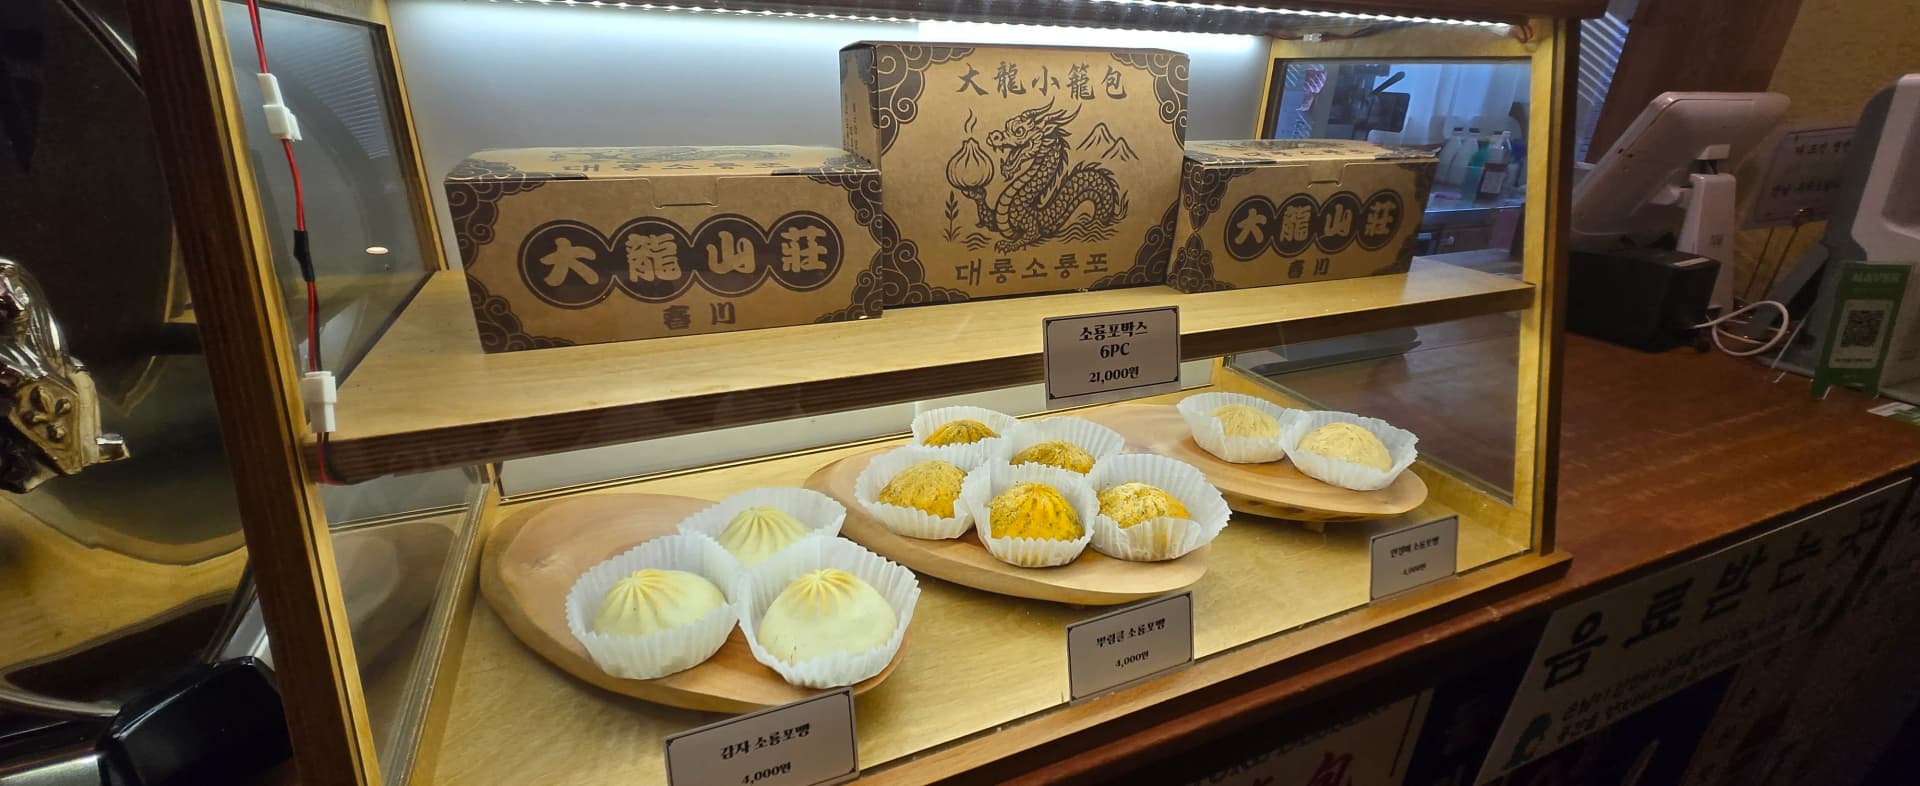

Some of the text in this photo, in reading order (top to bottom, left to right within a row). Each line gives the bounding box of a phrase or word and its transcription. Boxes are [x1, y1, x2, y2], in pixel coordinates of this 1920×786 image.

[956, 61, 1127, 100] 大龍小籠包
[1234, 196, 1397, 244] 大龍山莊
[539, 225, 829, 287] 大龍山莊
[955, 252, 1109, 286] 대룡소룡포
[1079, 321, 1149, 341] 소룡포박스
[1100, 342, 1130, 359] 6PC
[1089, 366, 1140, 384] 21,000원
[1128, 618, 1166, 638] 소룡포빵
[1115, 649, 1150, 669] 4,000원
[720, 722, 811, 760] 감자 소룡포빵
[741, 761, 792, 785] 4,000원
